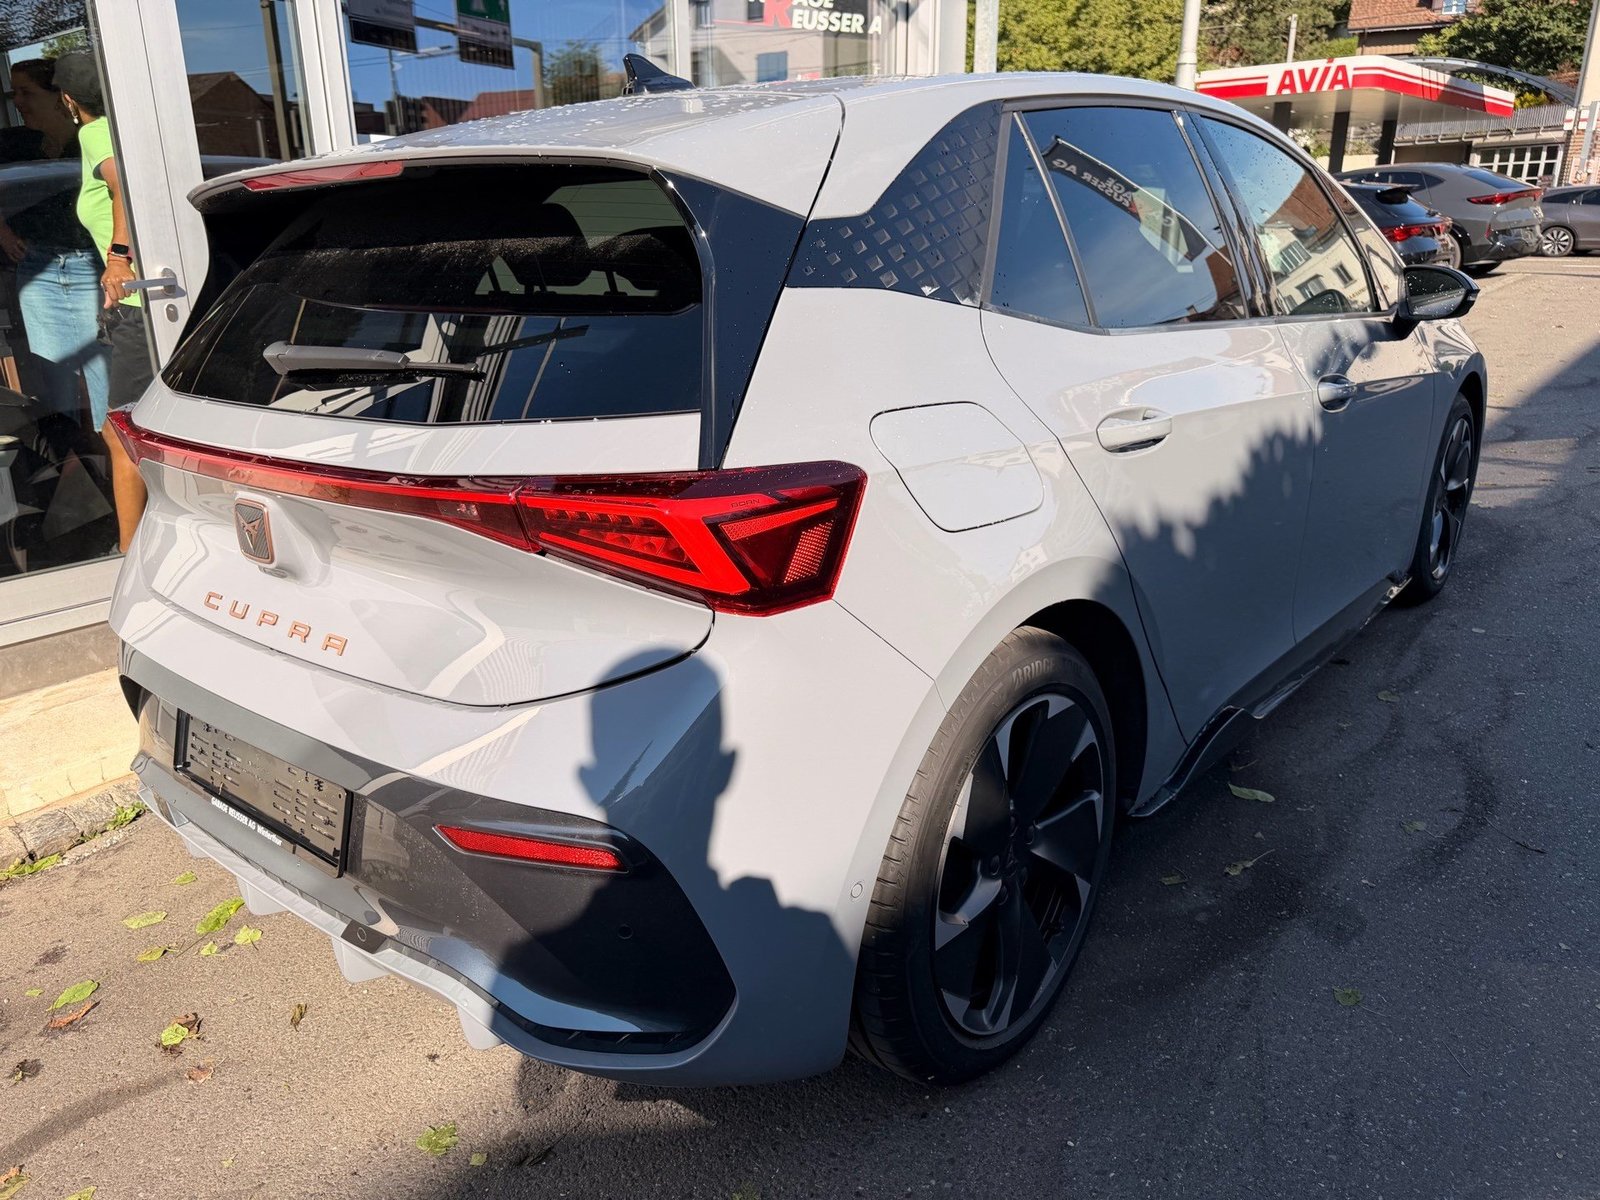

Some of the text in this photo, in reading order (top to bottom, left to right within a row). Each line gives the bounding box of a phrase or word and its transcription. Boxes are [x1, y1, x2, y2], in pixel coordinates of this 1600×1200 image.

[1276, 58, 1350, 95] AVIA
[203, 591, 348, 657] CUPRA
[248, 819, 256, 830] AG
